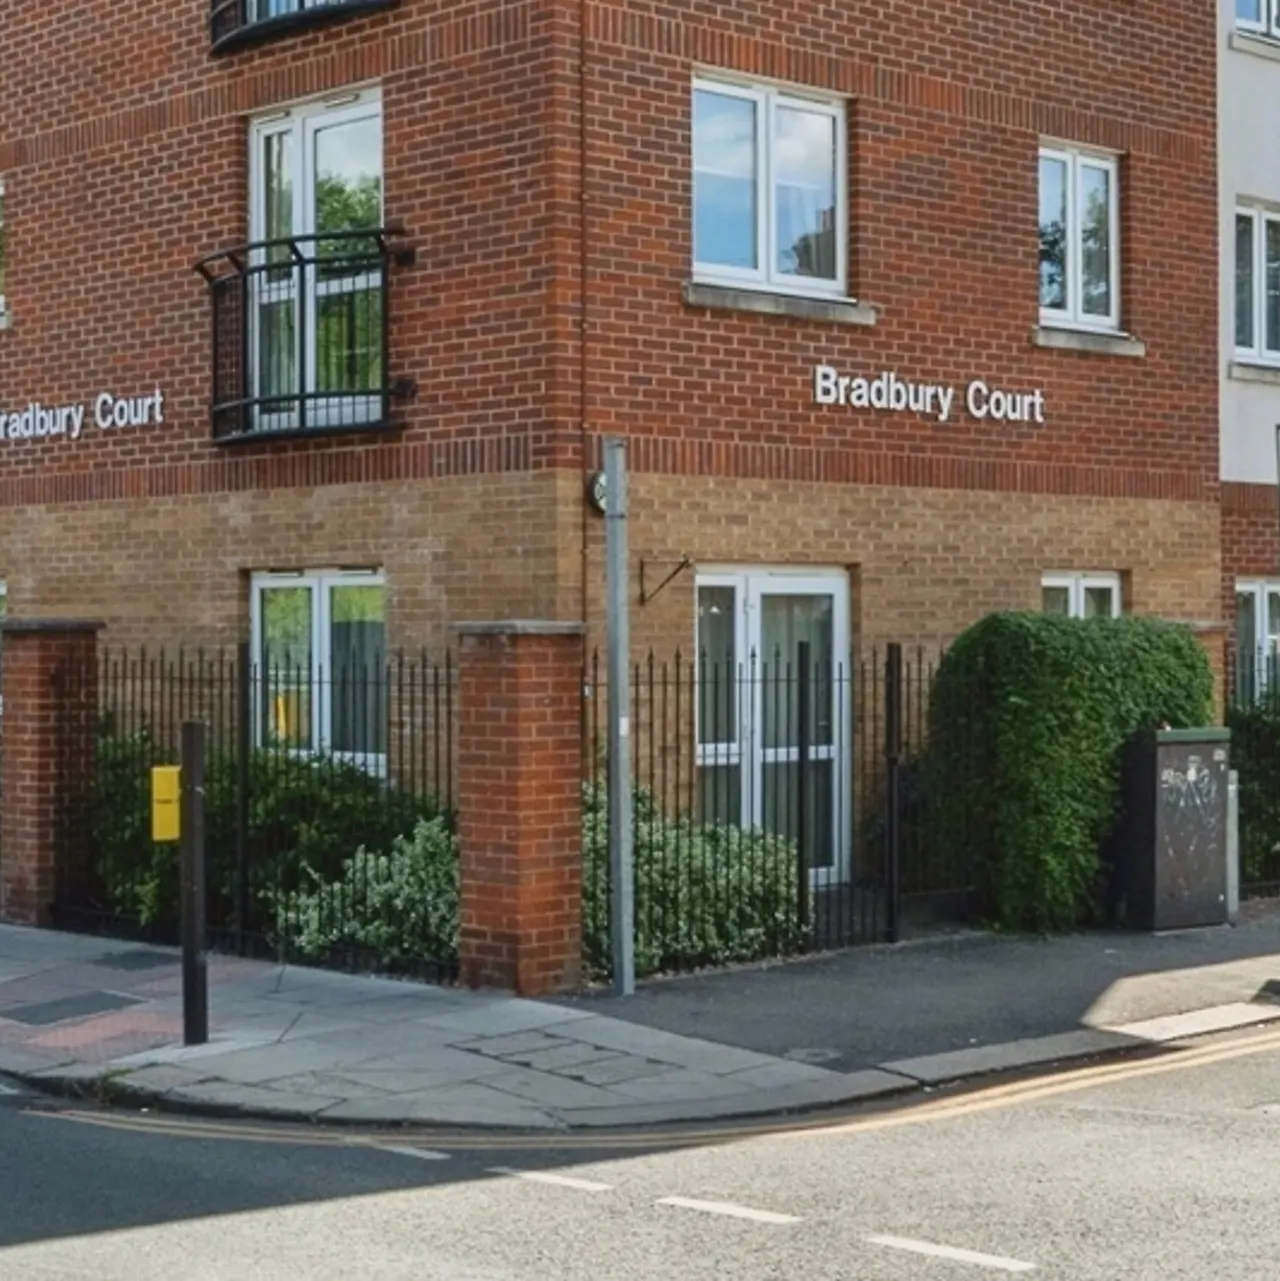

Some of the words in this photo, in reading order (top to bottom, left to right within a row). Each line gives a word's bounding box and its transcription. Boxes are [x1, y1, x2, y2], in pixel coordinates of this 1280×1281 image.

[94, 388, 164, 428] Court
[815, 364, 954, 421] Bradbury
[967, 380, 1045, 423] Court
